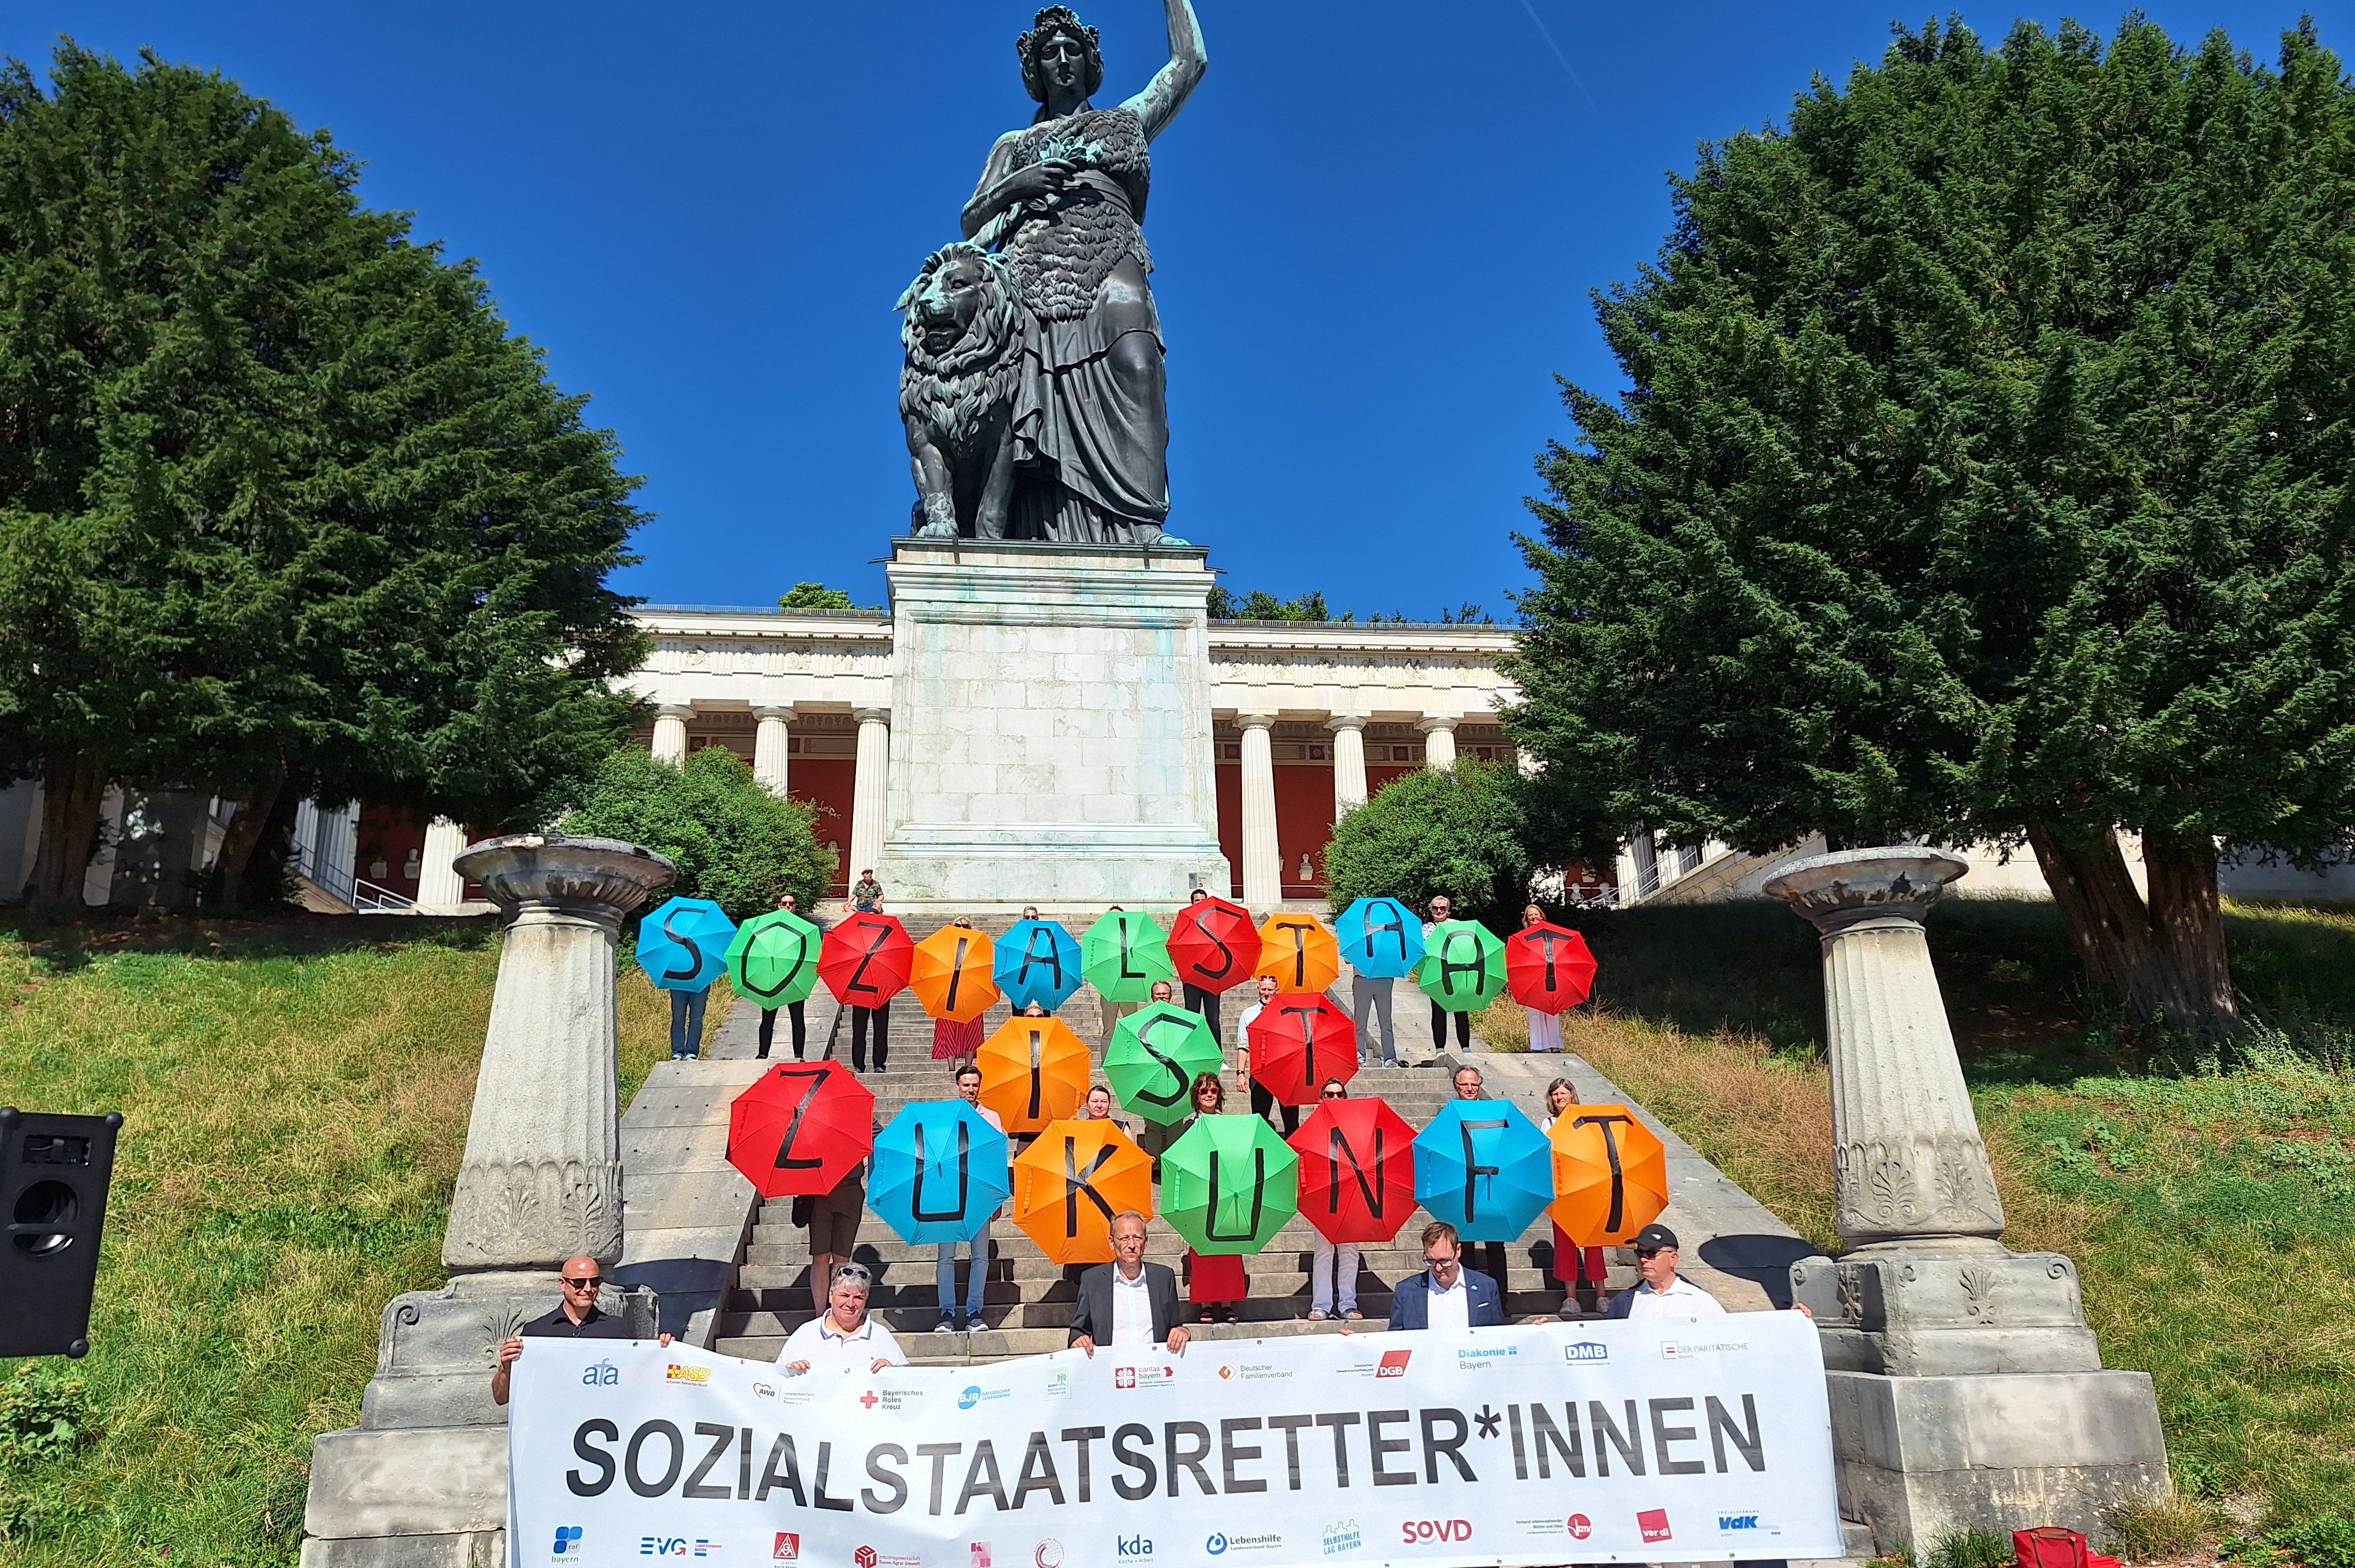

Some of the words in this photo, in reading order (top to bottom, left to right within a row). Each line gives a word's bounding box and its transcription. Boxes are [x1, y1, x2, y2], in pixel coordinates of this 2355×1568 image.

[1458, 1348, 1505, 1357] Diakonie
[1567, 1346, 1606, 1360] DMB
[1460, 1360, 1491, 1371] Bayern
[676, 1365, 711, 1382] ASB
[1241, 1371, 1293, 1379] Familienverband
[1380, 1367, 1404, 1376] DGB
[759, 1389, 775, 1397] AWO
[959, 1393, 980, 1402] BJR
[1230, 1534, 1281, 1544] Lebenshilfe
[1323, 1531, 1360, 1546] SELBSTHILFE
[1117, 1533, 1153, 1556] kda
[1324, 1545, 1335, 1555] LAG
[1337, 1539, 1361, 1552] BAYERN
[551, 1556, 579, 1564] bayern
